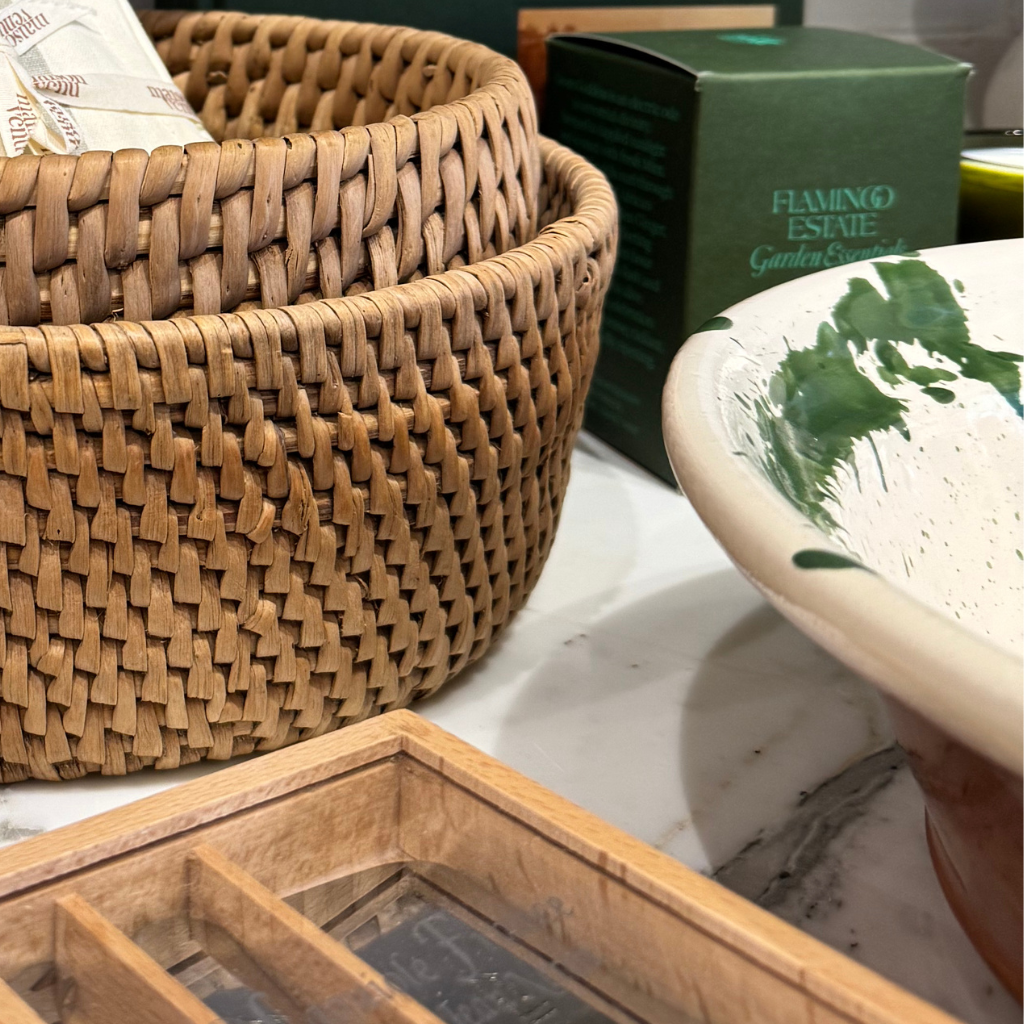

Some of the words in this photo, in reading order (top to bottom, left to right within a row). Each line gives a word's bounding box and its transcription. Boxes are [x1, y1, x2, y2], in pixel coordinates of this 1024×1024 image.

[4, 12, 51, 48] maiso
[771, 184, 896, 215] FLAMINGO
[787, 212, 879, 241] ESTATE
[749, 243, 824, 279] Garden
